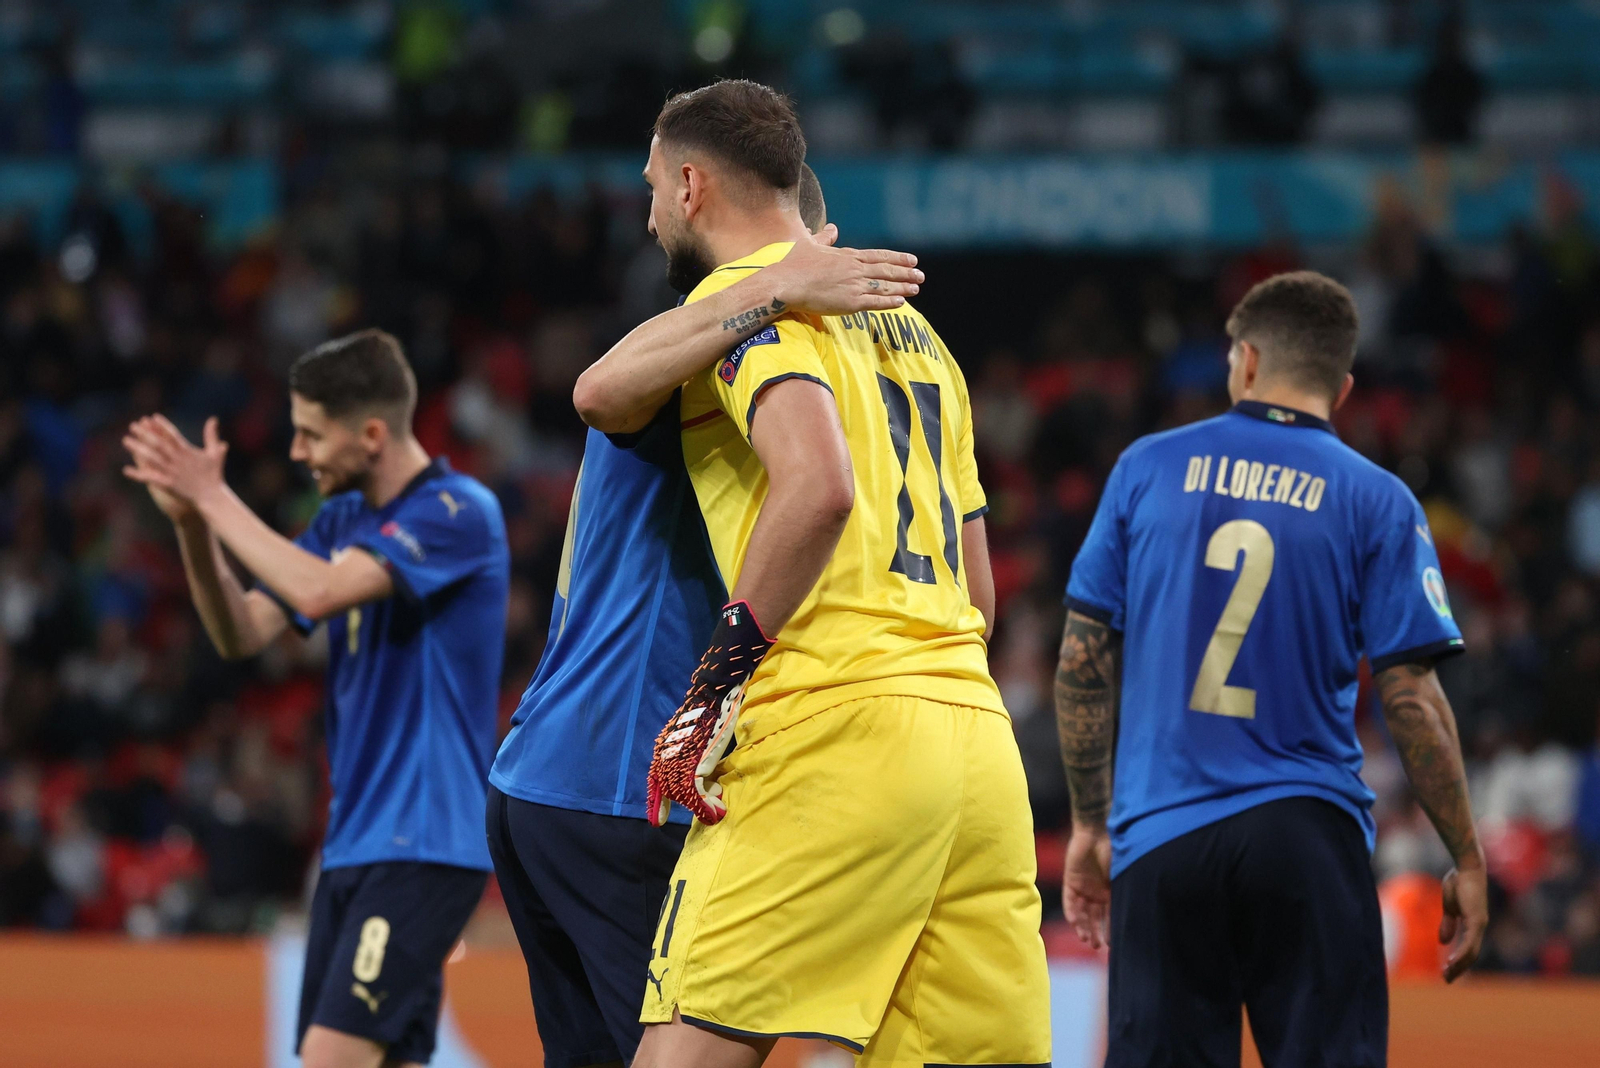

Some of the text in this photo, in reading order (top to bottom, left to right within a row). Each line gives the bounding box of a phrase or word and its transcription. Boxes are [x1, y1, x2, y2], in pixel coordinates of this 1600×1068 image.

[730, 329, 777, 364] RESPECT
[876, 371, 961, 589] 21
[1184, 455, 1326, 512] DI LORENZO
[1189, 519, 1275, 719] 2
[352, 915, 391, 983] 8
